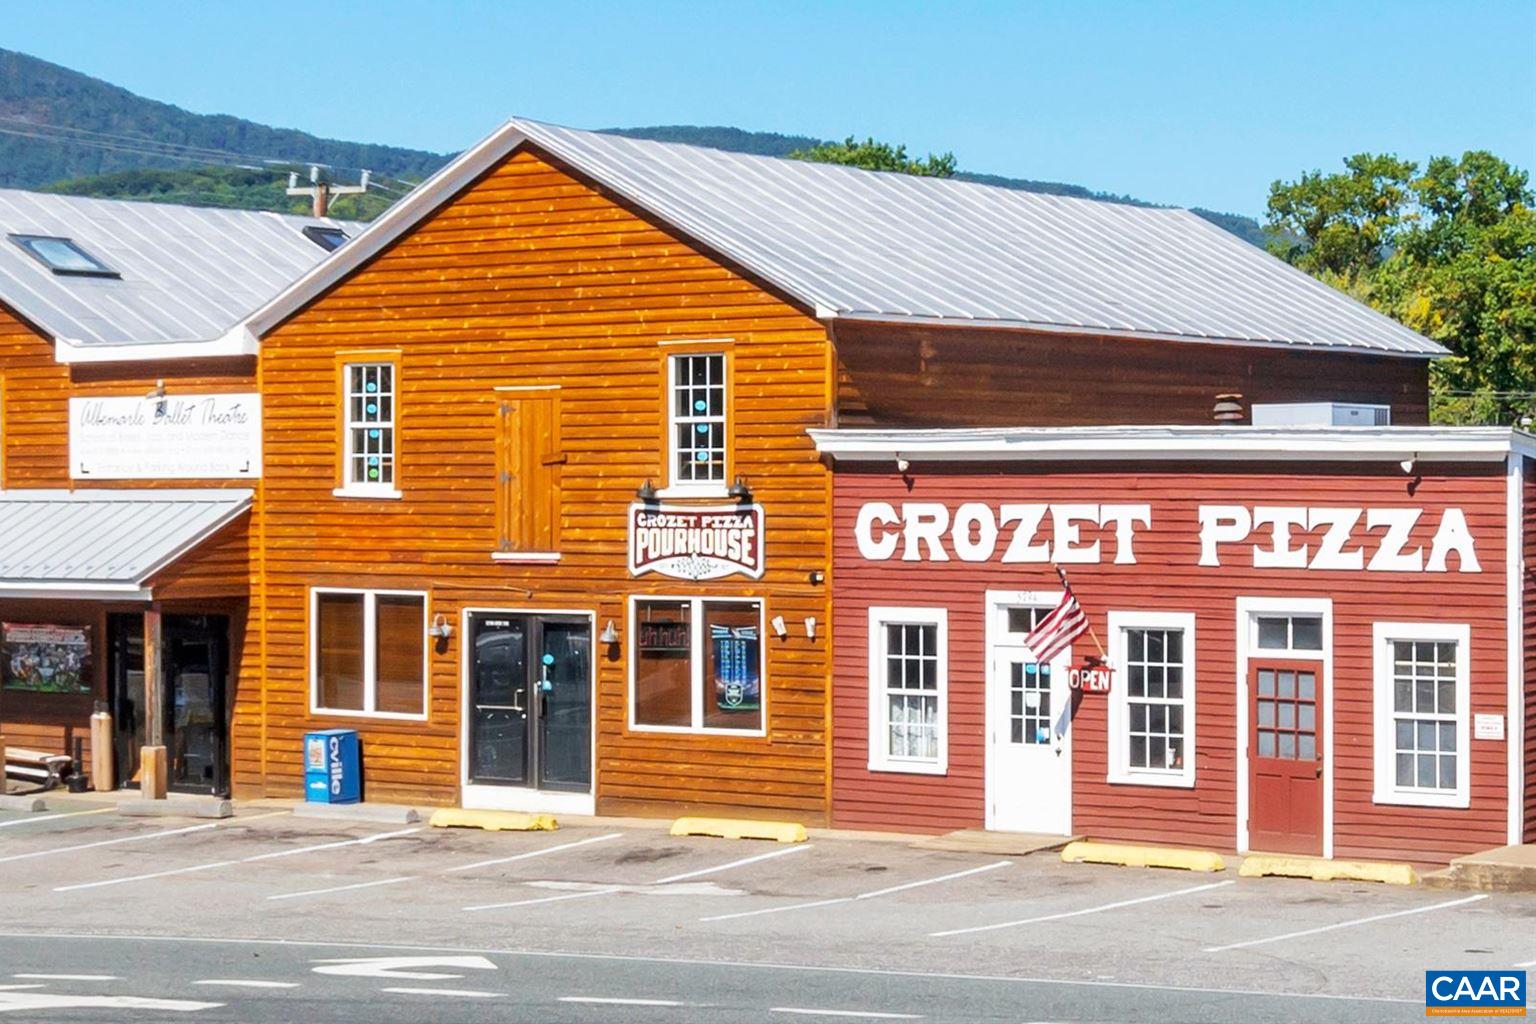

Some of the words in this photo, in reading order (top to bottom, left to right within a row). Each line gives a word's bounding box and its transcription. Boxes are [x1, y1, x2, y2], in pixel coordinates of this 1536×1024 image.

[80, 400, 146, 426] Albemarle
[152, 399, 196, 425] Ballet
[201, 397, 248, 425] Theatre
[637, 513, 697, 528] CROZET
[701, 515, 754, 529] PIZZA
[635, 527, 756, 566] POURHOUSE
[854, 502, 1151, 564] CROZET
[1198, 505, 1482, 572] PIZZA
[1069, 669, 1110, 690] OPEN
